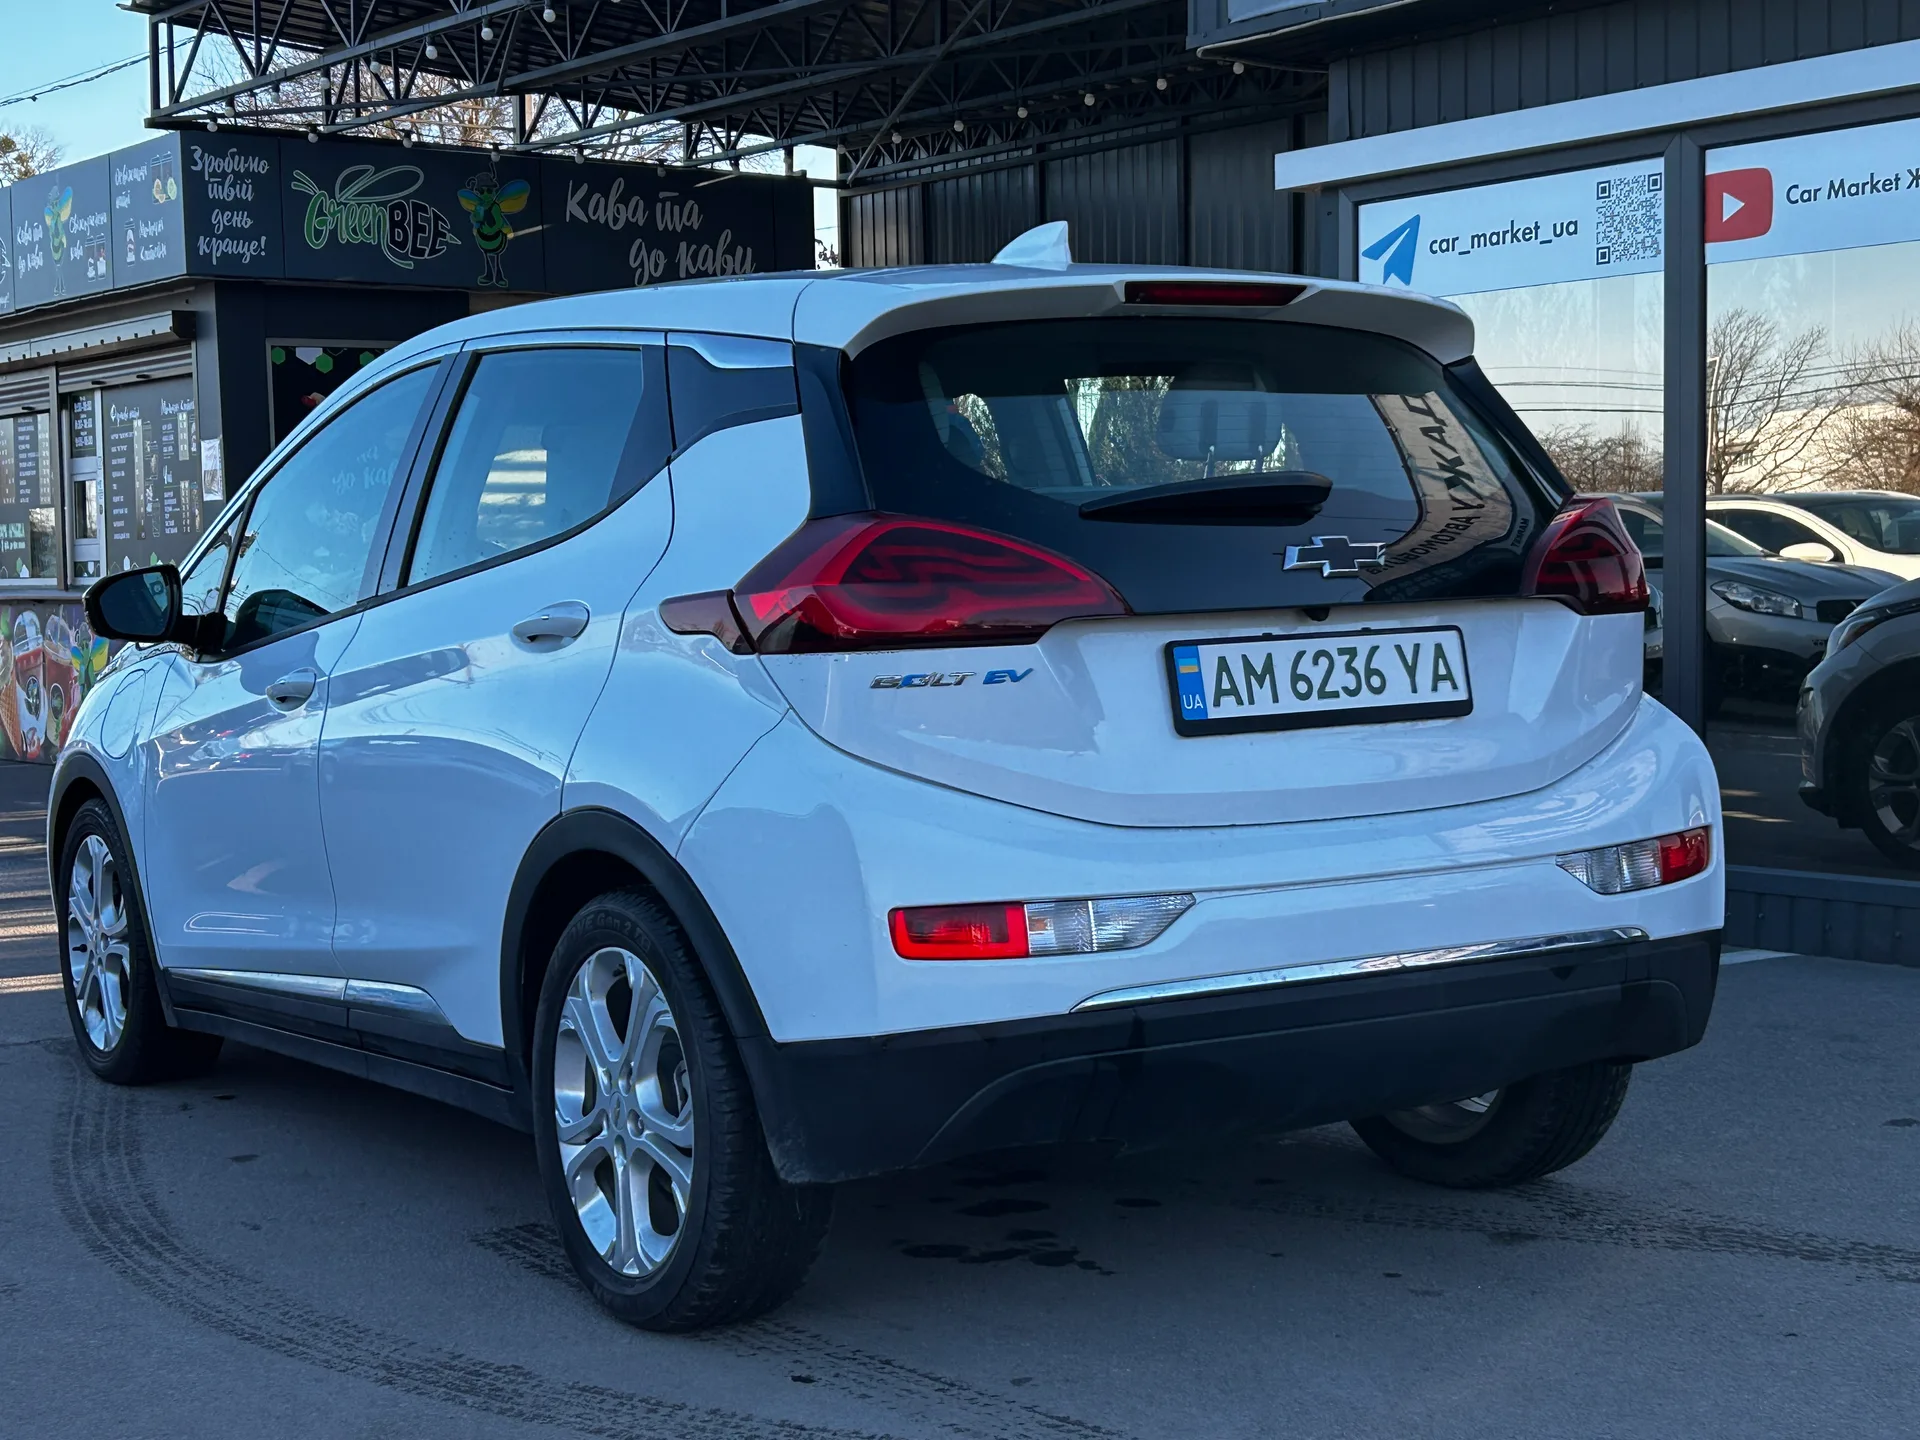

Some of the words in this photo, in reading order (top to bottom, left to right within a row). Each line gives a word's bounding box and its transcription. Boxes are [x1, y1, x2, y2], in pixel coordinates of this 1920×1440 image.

[190, 145, 269, 180] Зробимо
[208, 174, 254, 201] твій
[1785, 184, 1822, 204] Car
[1827, 172, 1901, 200] Market
[566, 177, 648, 230] Кава
[656, 191, 703, 232] та
[211, 208, 253, 234] день
[197, 235, 266, 265] краще!
[1429, 219, 1578, 256] car_market_ua
[629, 238, 667, 286] до
[675, 229, 756, 277] кави
[870, 671, 977, 690] BOLT
[982, 667, 1035, 686] EV
[1212, 652, 1279, 708] AM
[1289, 644, 1387, 701] 6236
[1393, 642, 1459, 693] YA
[1182, 693, 1204, 710] UA
